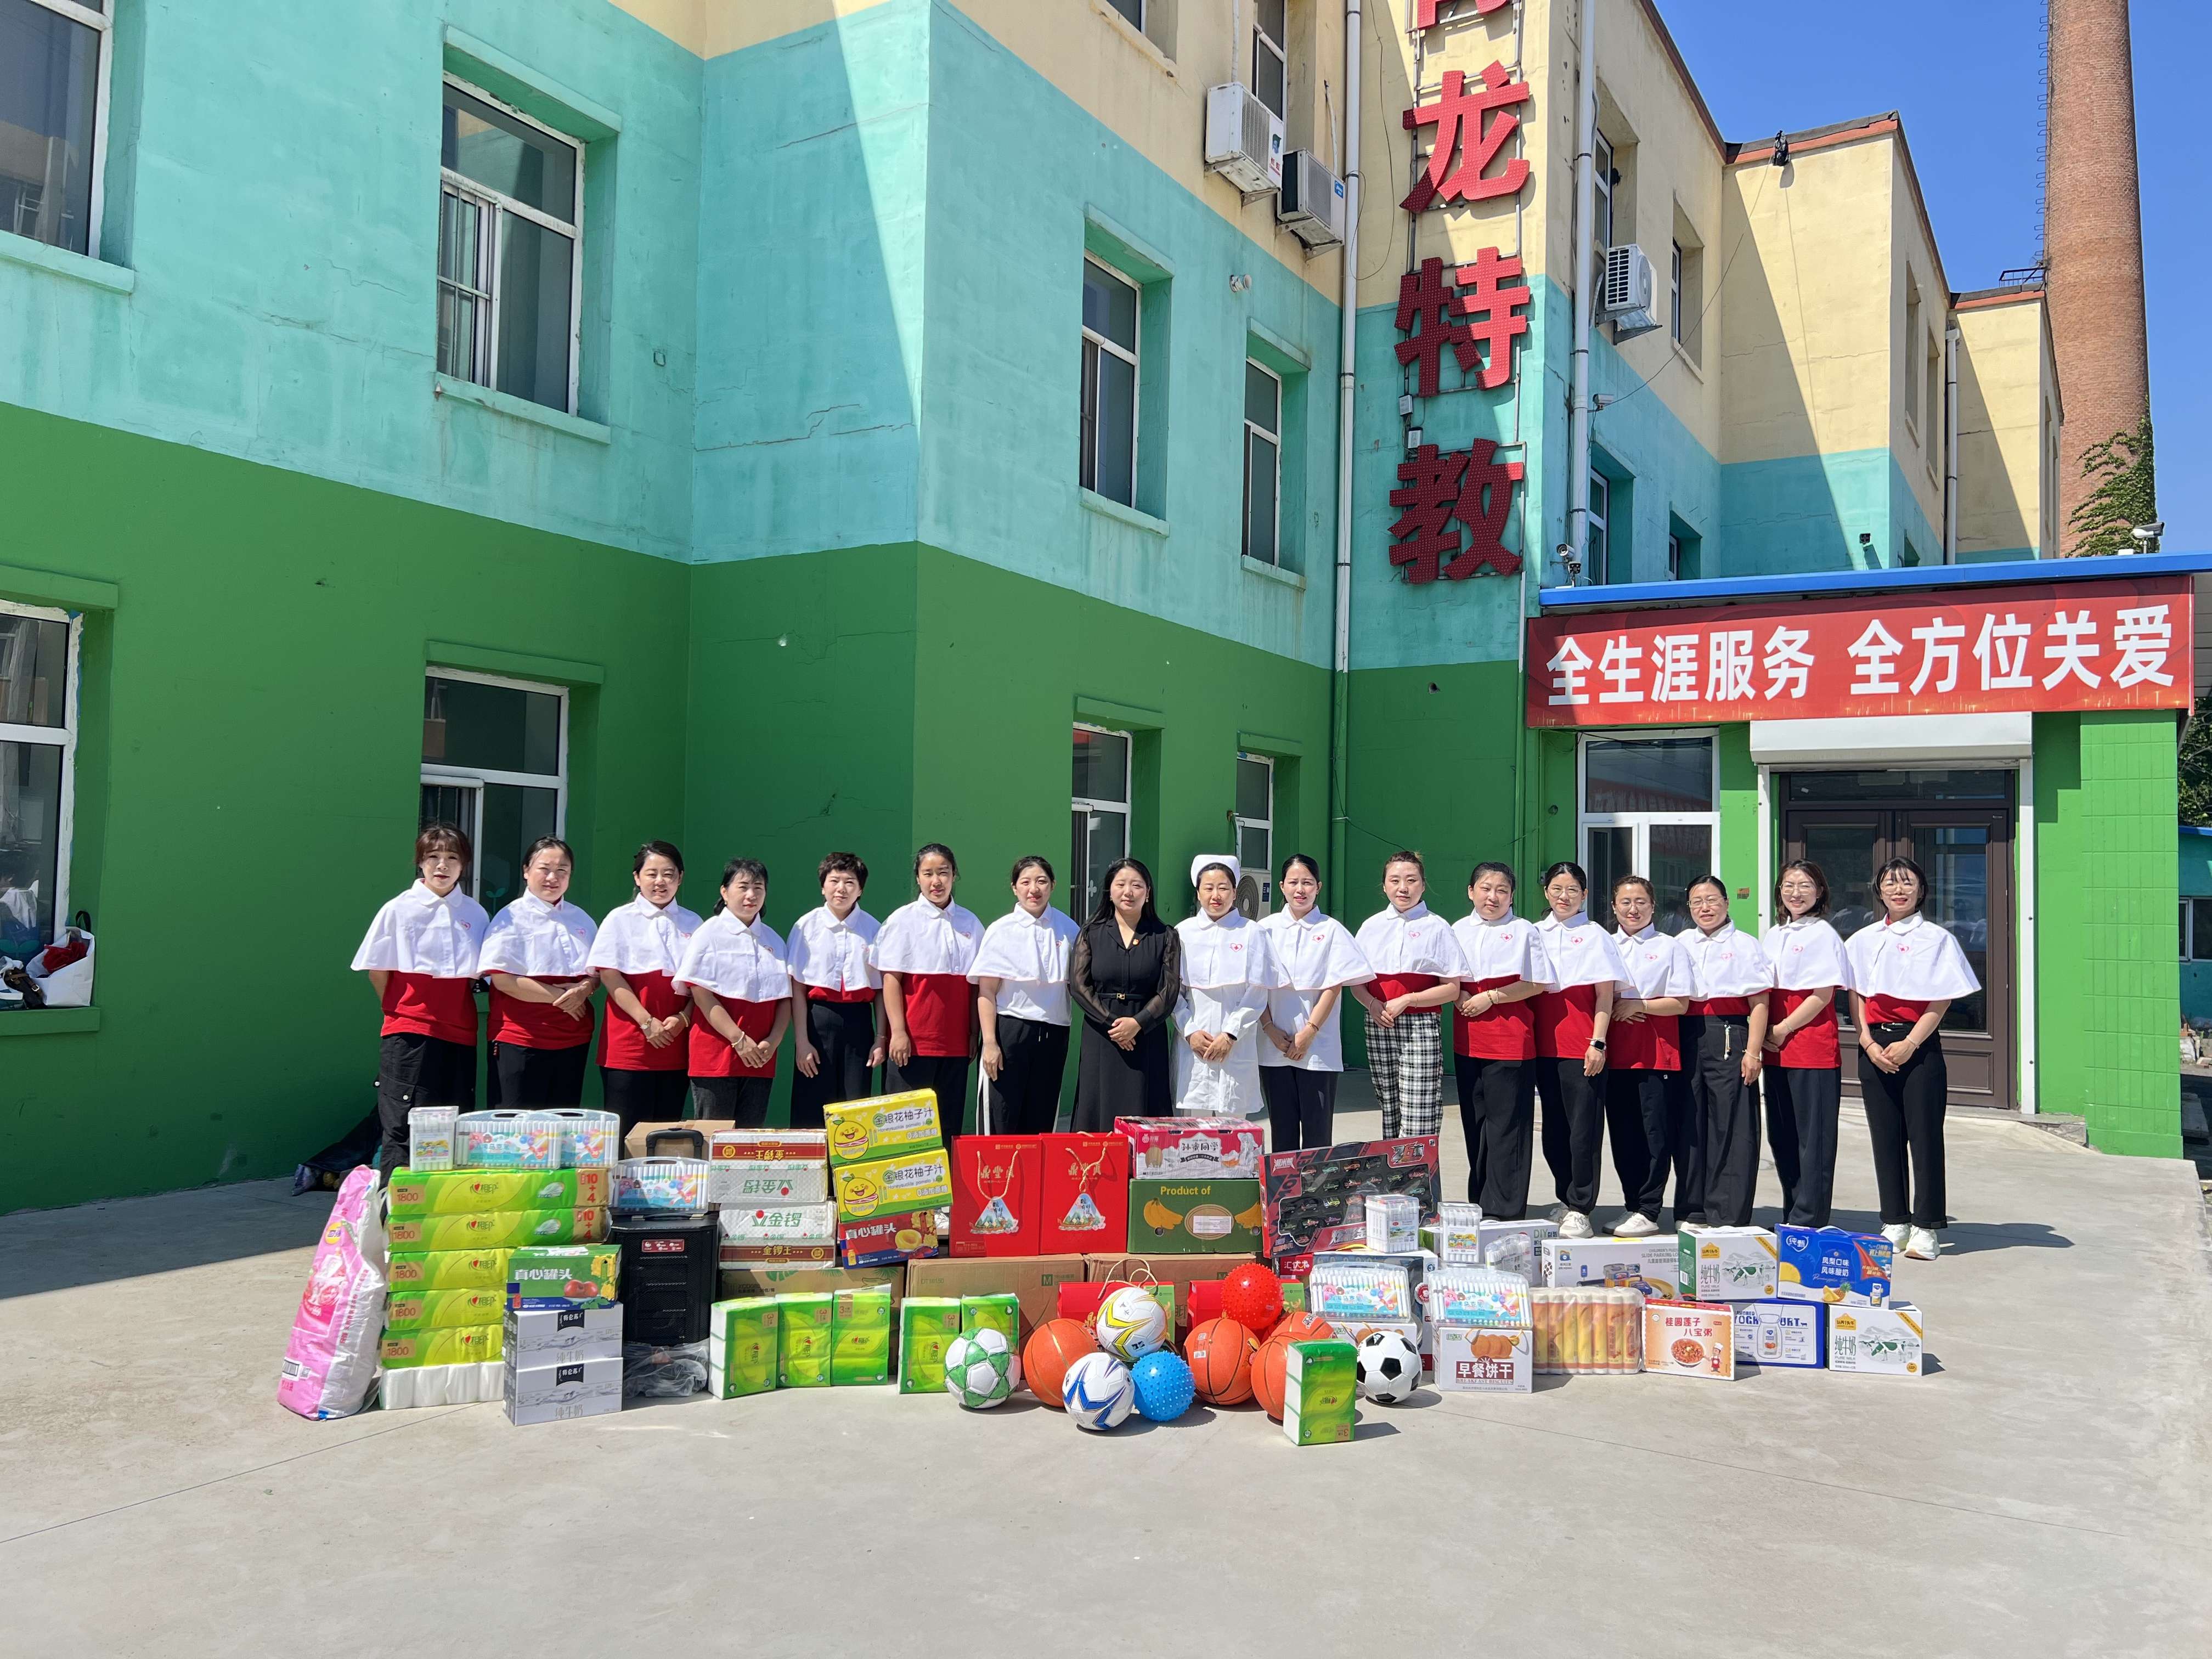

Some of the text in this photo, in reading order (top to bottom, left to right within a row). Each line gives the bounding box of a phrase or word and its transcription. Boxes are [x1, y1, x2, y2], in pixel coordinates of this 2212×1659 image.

[1387, 0, 1531, 584] 龙特教
[1546, 603, 2174, 706] 全生涯服务 全方位关爱
[873, 1107, 933, 1124] 金银花柚子汁
[884, 1164, 943, 1182] 金银花柚子汁
[1160, 1185, 1211, 1195] Product of
[397, 1193, 418, 1201] 1800
[393, 1231, 415, 1239] 1800
[1534, 1229, 1548, 1238] DIY
[1821, 1257, 1849, 1266] 凤梨口味
[396, 1270, 417, 1278] 1800
[515, 1268, 572, 1280] 真心罐头
[1701, 1264, 1720, 1284] 纯牛奶
[1821, 1267, 1849, 1277] 风味酸奶
[395, 1307, 416, 1317] 1800
[1666, 1317, 1701, 1327] 桂圆莲子
[1683, 1328, 1712, 1336] 八宝粥
[1835, 1335, 1857, 1356] 纯牛奶
[387, 1347, 409, 1356] 1800
[1458, 1363, 1513, 1378] 早餐饼干
